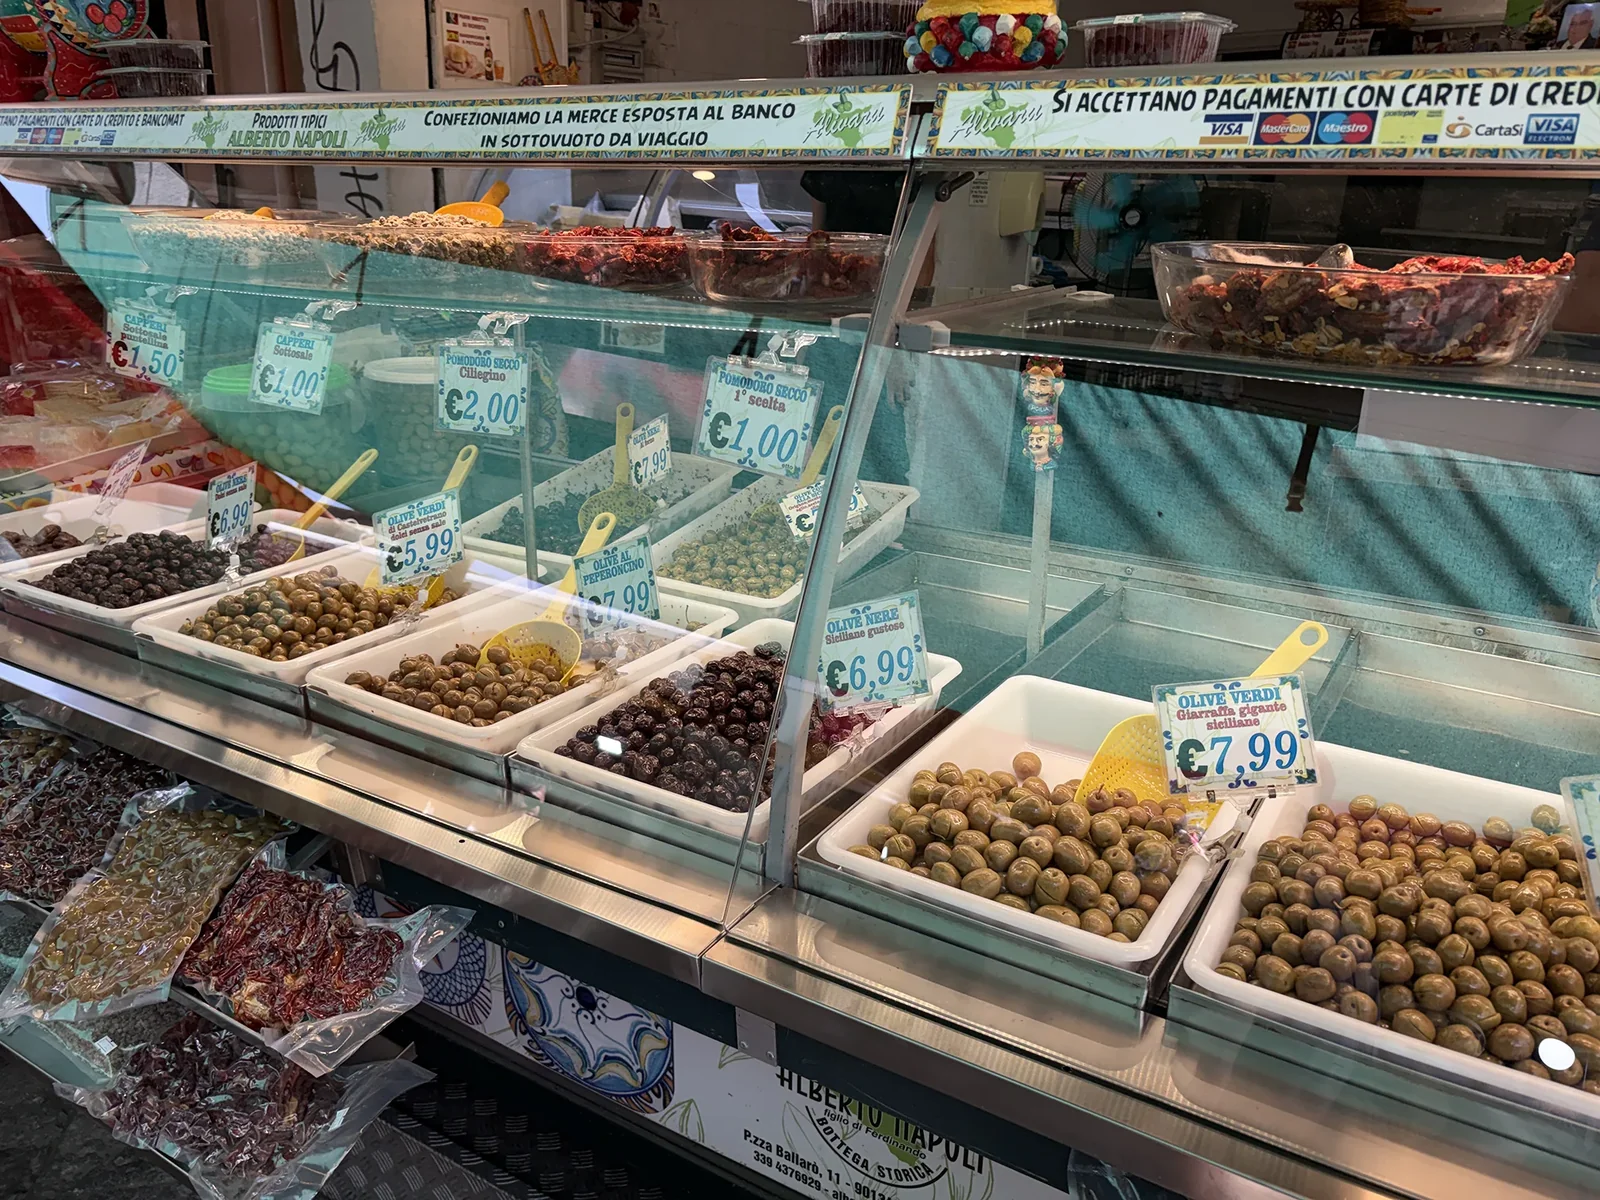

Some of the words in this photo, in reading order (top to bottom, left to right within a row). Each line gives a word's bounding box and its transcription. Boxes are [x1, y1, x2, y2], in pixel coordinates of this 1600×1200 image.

[1075, 90, 1197, 112] ACCETTANO
[1202, 86, 1337, 110] PAGAMENTI
[1344, 85, 1396, 108] CON
[1401, 82, 1483, 107] CARTE
[1489, 82, 1519, 106] DI
[19, 114, 57, 127] PAGAMENTI
[57, 114, 72, 127] CON
[72, 114, 95, 127] CARTE
[95, 114, 104, 127] DI
[104, 114, 136, 127] CREDITO
[135, 114, 142, 126] E
[141, 113, 185, 127] BANCOMAT
[300, 114, 328, 128] TIPICI
[544, 111, 563, 124] LA
[567, 108, 618, 124] MERCE
[622, 105, 698, 122] ESPOSTA
[703, 105, 724, 120] AL
[731, 103, 796, 119] BANCO
[1210, 123, 1244, 136] VISA
[1260, 124, 1310, 134] MasterCard
[1323, 123, 1368, 134] Maestro
[1475, 123, 1524, 137] CartaSi
[1534, 118, 1575, 133] VISA
[227, 130, 290, 148] ALBERTO
[292, 130, 348, 149] NAPOLI
[480, 135, 497, 148] IN
[501, 133, 605, 148] SOTTOVUOTO
[609, 133, 632, 146] DA
[637, 131, 709, 146] VIAGGIO
[1527, 135, 1573, 143] ELECTRON
[123, 323, 168, 341] Sottosale
[124, 314, 167, 333] CAPPERI
[273, 344, 313, 361] Sottosale
[276, 335, 316, 350] CAPPERI
[111, 340, 178, 378] €1,50
[446, 354, 492, 368] POMODORO
[493, 358, 520, 371] SECCO
[259, 364, 319, 399] €1,00
[459, 366, 506, 383] Ciliegino
[718, 371, 774, 394] POMODORO
[775, 383, 808, 403] SECCO
[445, 388, 519, 425] €2,00
[748, 393, 786, 413] scelta
[708, 411, 799, 462] €1,00
[215, 481, 232, 494] OLIVE
[388, 510, 415, 526] OLIVE
[416, 501, 446, 518] VERDI
[388, 524, 396, 534] di
[390, 531, 408, 541] dolci
[409, 523, 430, 536] senza
[431, 518, 447, 528] sale
[386, 528, 454, 573] €5,99
[593, 553, 619, 571] OLIVE
[621, 550, 632, 563] AL
[583, 557, 645, 586] PEPERONCINO
[827, 615, 863, 634] OLIVE
[865, 607, 900, 626] NERE
[825, 629, 866, 645] Siciliane
[867, 621, 905, 639] gustose
[825, 646, 915, 697] €6,99
[1178, 693, 1226, 709] OLIVE
[1230, 687, 1282, 703] VERDI
[1176, 706, 1236, 721] Giarraffa
[1239, 701, 1287, 719] gigante
[1206, 717, 1260, 731] siciliane
[1176, 730, 1298, 781] €7,99
[823, 1108, 850, 1126] figlio
[852, 1120, 863, 1132] di
[865, 1126, 927, 1160] Ferdinando
[743, 1128, 773, 1153] P.zza
[776, 1144, 823, 1179] Ballarò,
[827, 1169, 840, 1185] 11
[816, 1117, 869, 1172] BOTTEGA
[877, 1162, 935, 1182] STORICA
[753, 1150, 773, 1168] 339
[775, 1161, 822, 1192] 4376929
